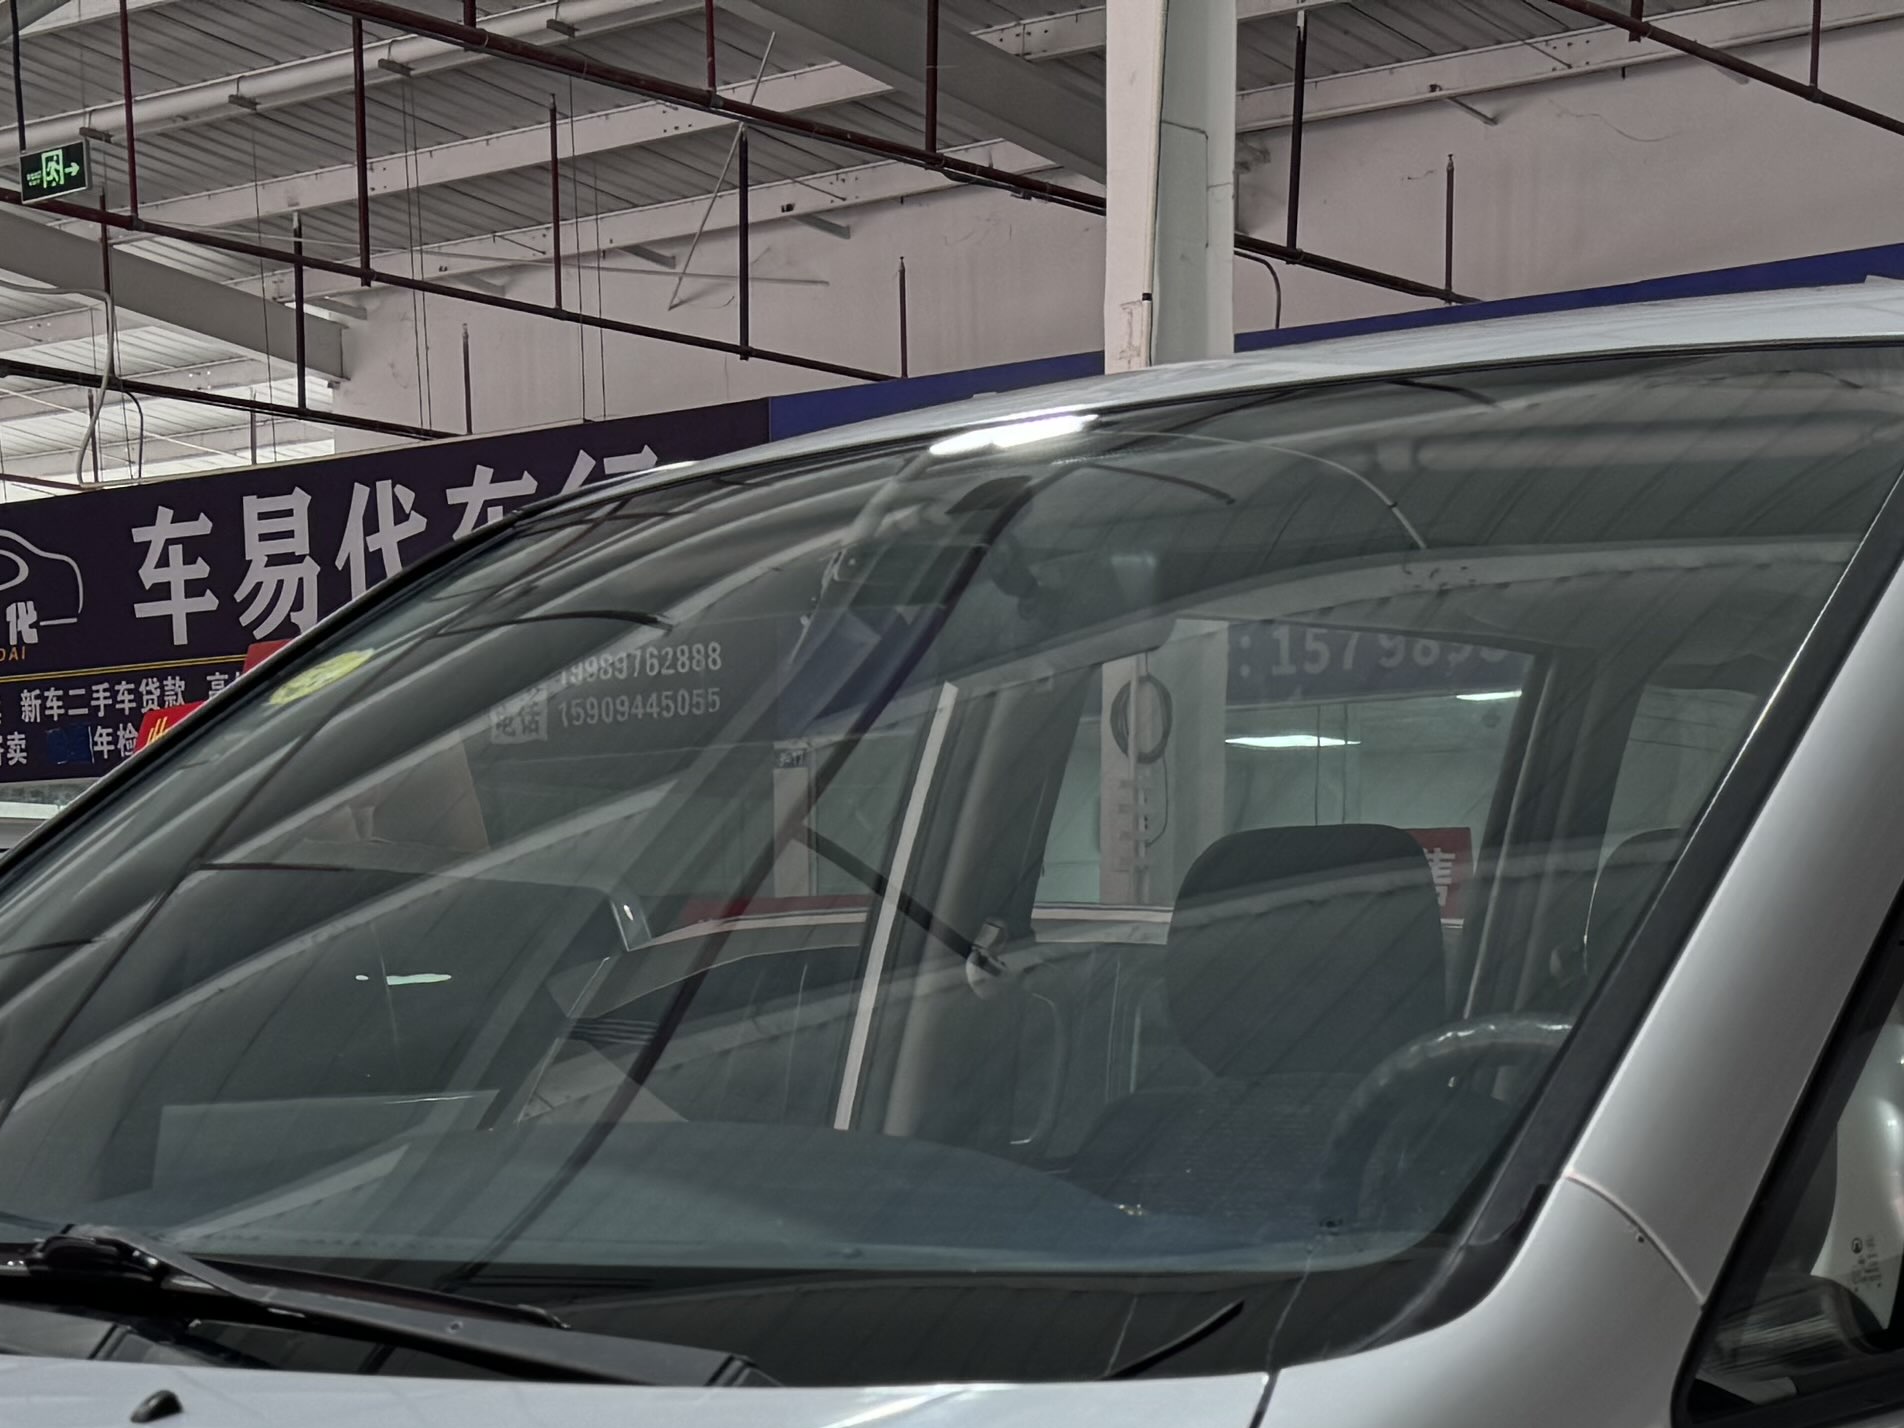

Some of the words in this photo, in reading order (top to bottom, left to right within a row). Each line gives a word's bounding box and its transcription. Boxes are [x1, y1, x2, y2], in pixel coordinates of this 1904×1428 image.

[20, 675, 186, 723] 新车二手车贷款
[206, 671, 241, 700] 高
[559, 687, 721, 728] 15909445055
[93, 722, 138, 759] 年检
